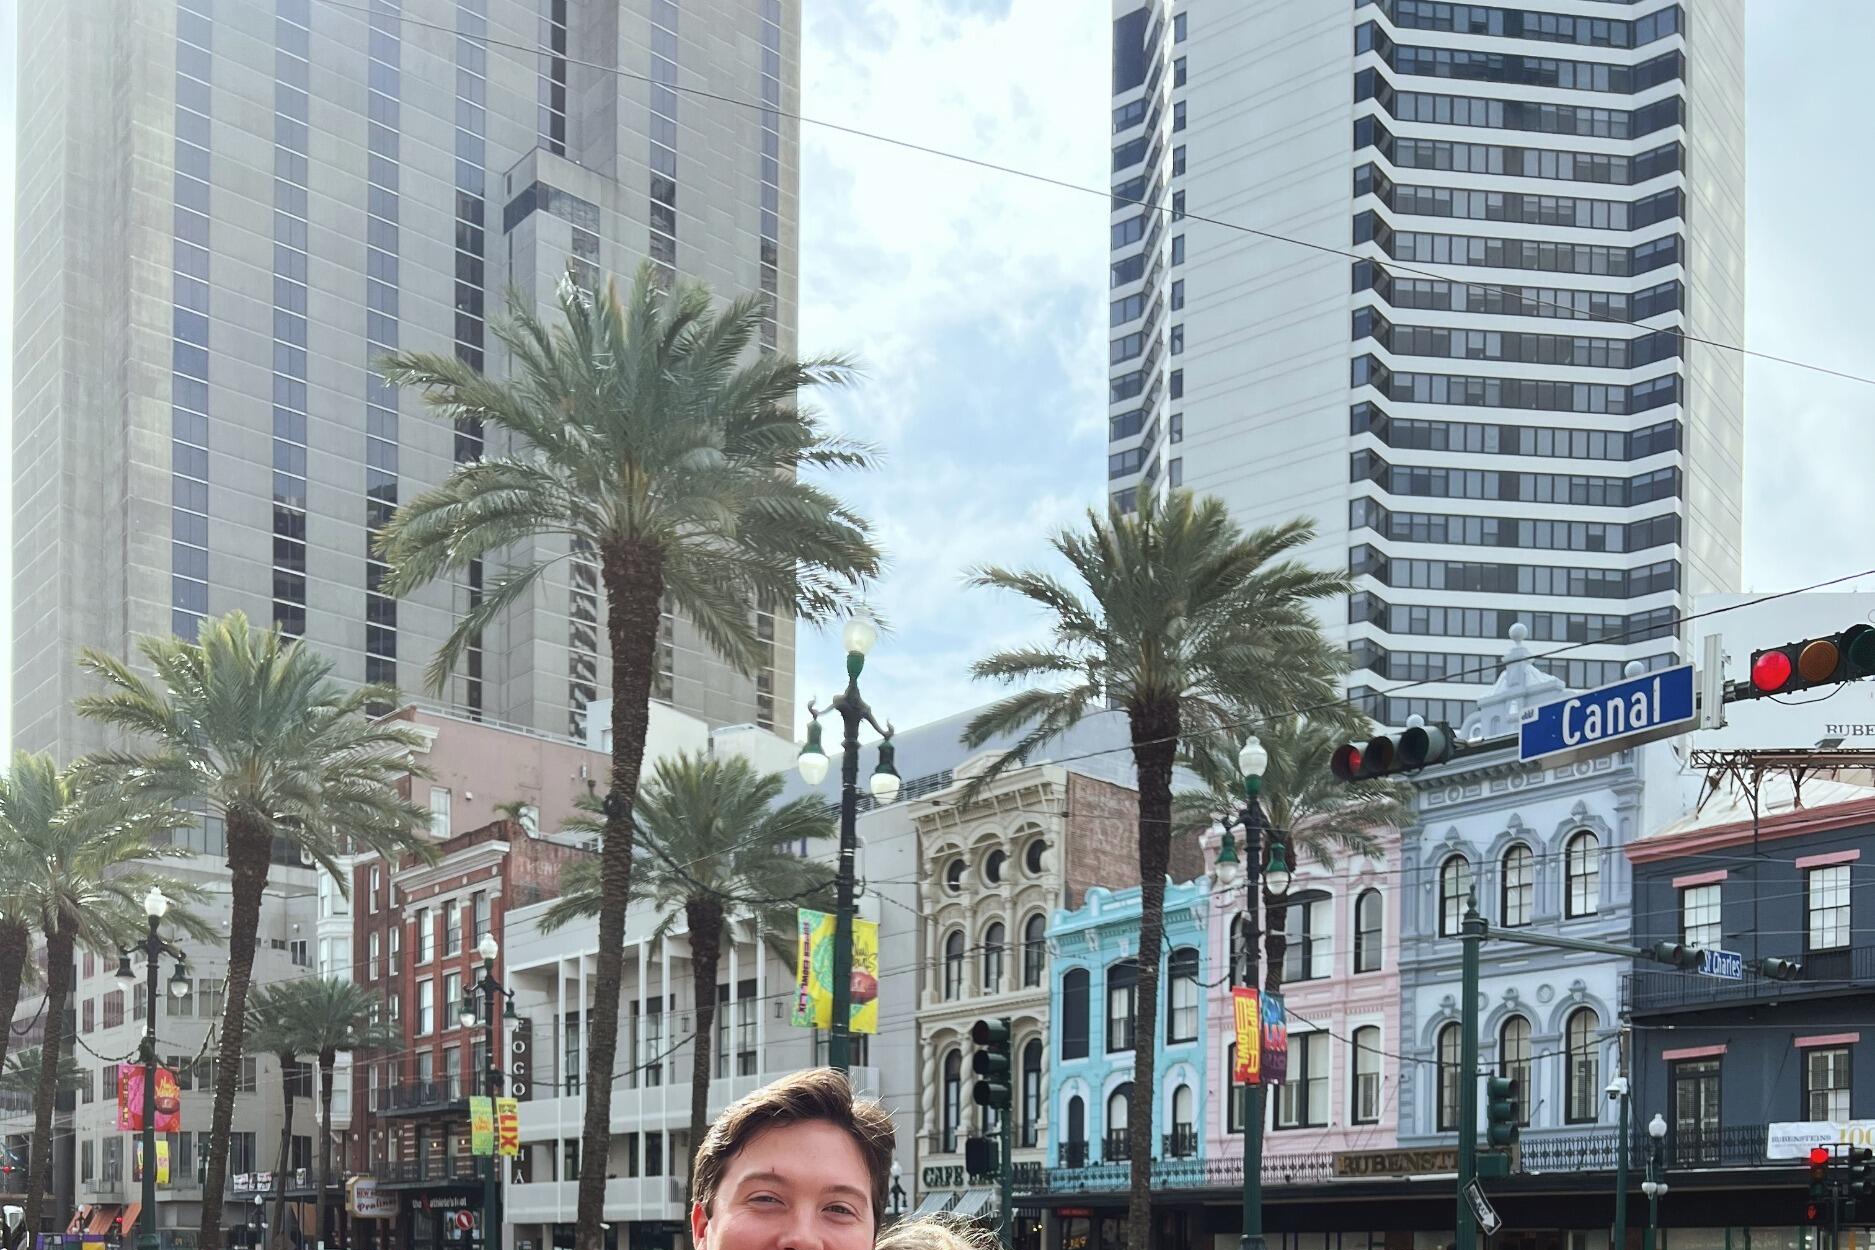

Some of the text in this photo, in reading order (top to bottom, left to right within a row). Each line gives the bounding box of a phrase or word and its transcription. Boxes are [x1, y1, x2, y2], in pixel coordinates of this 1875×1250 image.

[1562, 676, 1660, 745] Canal
[1712, 951, 1740, 977] Charles
[1235, 996, 1249, 1072] BOWL
[1247, 998, 1259, 1073] SUPER
[923, 1165, 964, 1188] CAFE
[1338, 1149, 1512, 1175] RUBENST
